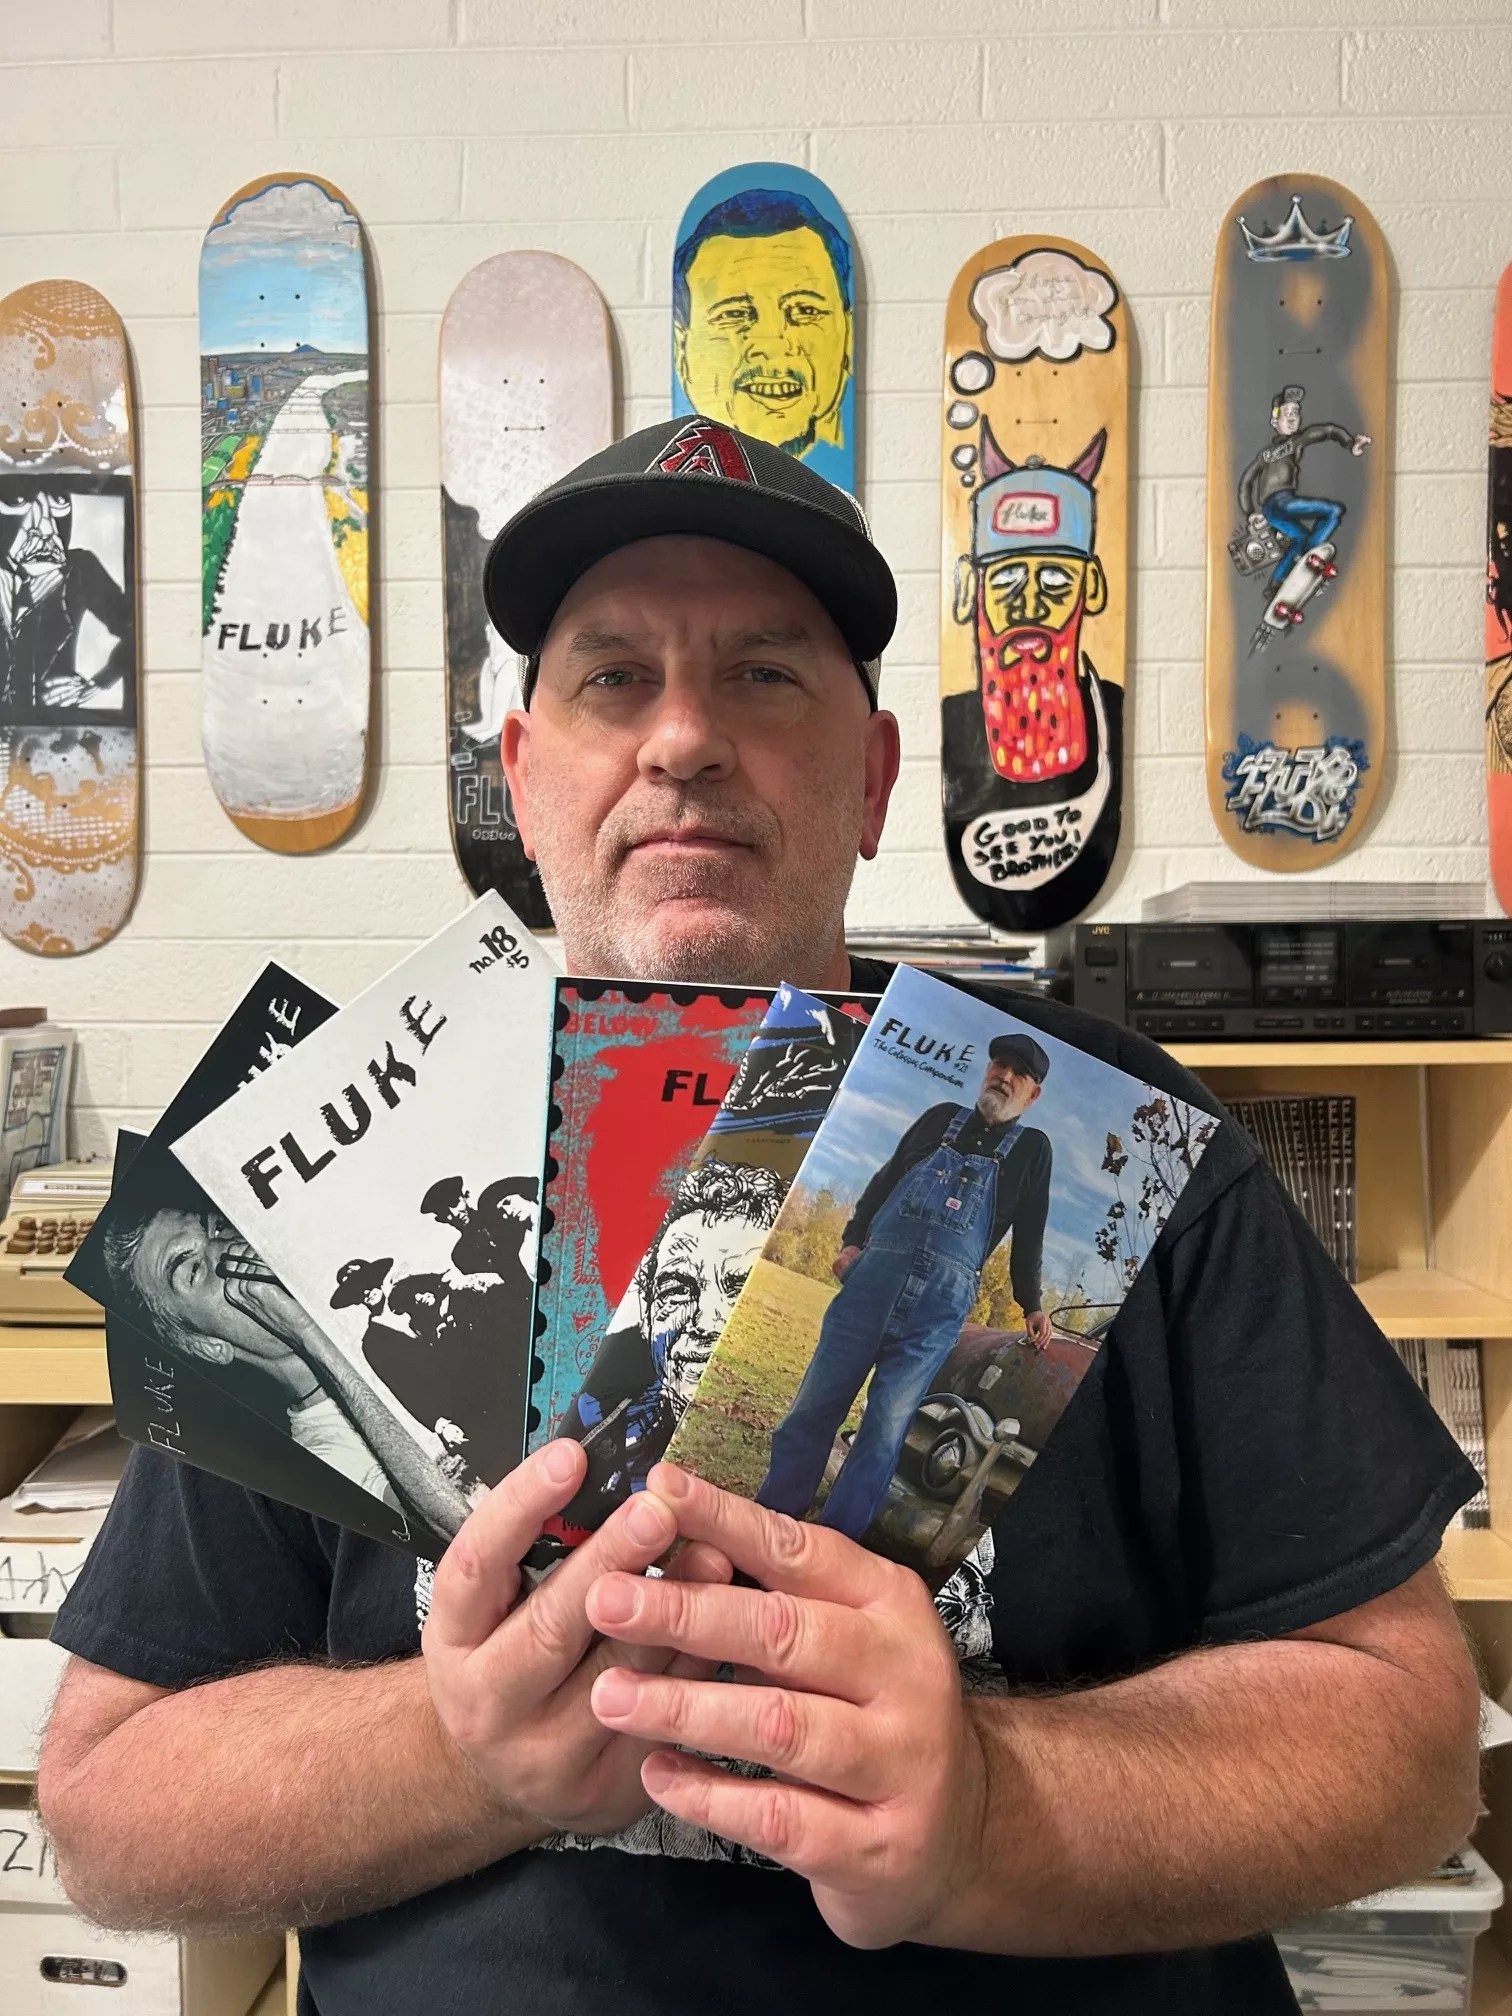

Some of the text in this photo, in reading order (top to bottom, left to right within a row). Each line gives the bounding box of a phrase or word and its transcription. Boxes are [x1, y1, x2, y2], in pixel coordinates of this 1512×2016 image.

[217, 606, 348, 651] FLUKE
[974, 806, 1081, 847] GOOD TO
[974, 841, 1019, 866] SEE
[479, 925, 517, 960] 18
[1092, 926, 1110, 935] JVC
[506, 949, 529, 969] $5
[873, 1038, 887, 1052] The
[880, 1018, 975, 1062] FLUKE
[241, 995, 447, 1209] FLUKE
[661, 1070, 737, 1106] FL
[144, 1357, 186, 1455] FLUKE
